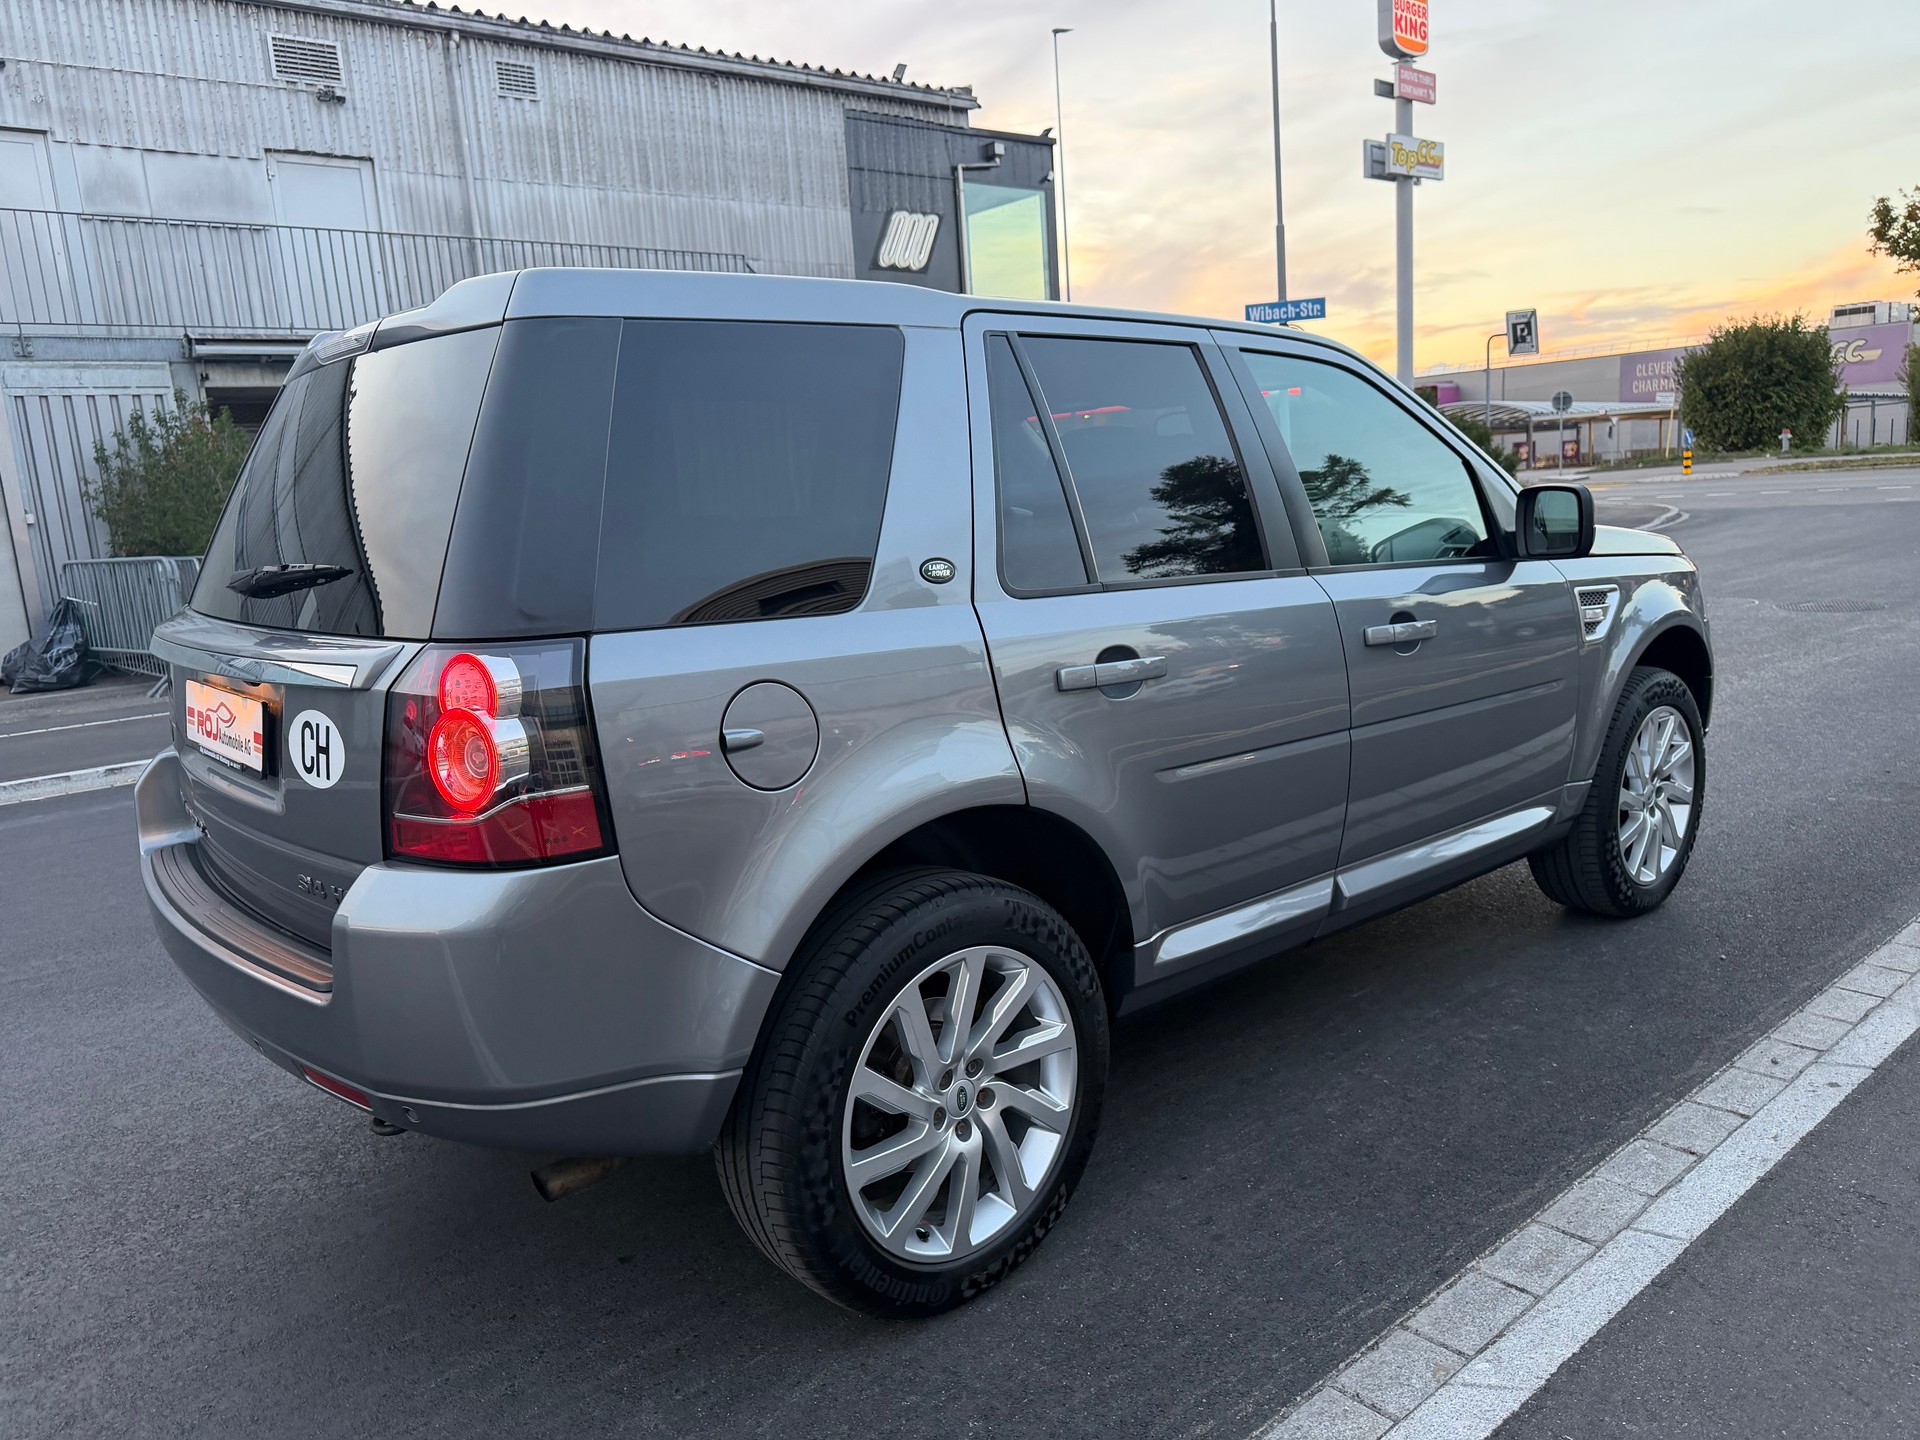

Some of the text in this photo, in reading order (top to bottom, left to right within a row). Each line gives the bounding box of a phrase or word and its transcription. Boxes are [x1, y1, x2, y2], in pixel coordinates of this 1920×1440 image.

[1394, 0, 1427, 20] BURGER
[1395, 12, 1427, 41] KING
[1391, 140, 1436, 174] TopCC
[1248, 302, 1321, 321] Wibach-Str.
[1830, 338, 1868, 364] CC
[1636, 361, 1673, 377] CLEVER
[1632, 378, 1676, 393] CHARMA
[931, 569, 951, 577] ROVER
[197, 709, 219, 742] ROJ
[218, 728, 252, 756] Automobile AG
[301, 720, 330, 780] CH
[843, 908, 977, 1028] PremiumConta
